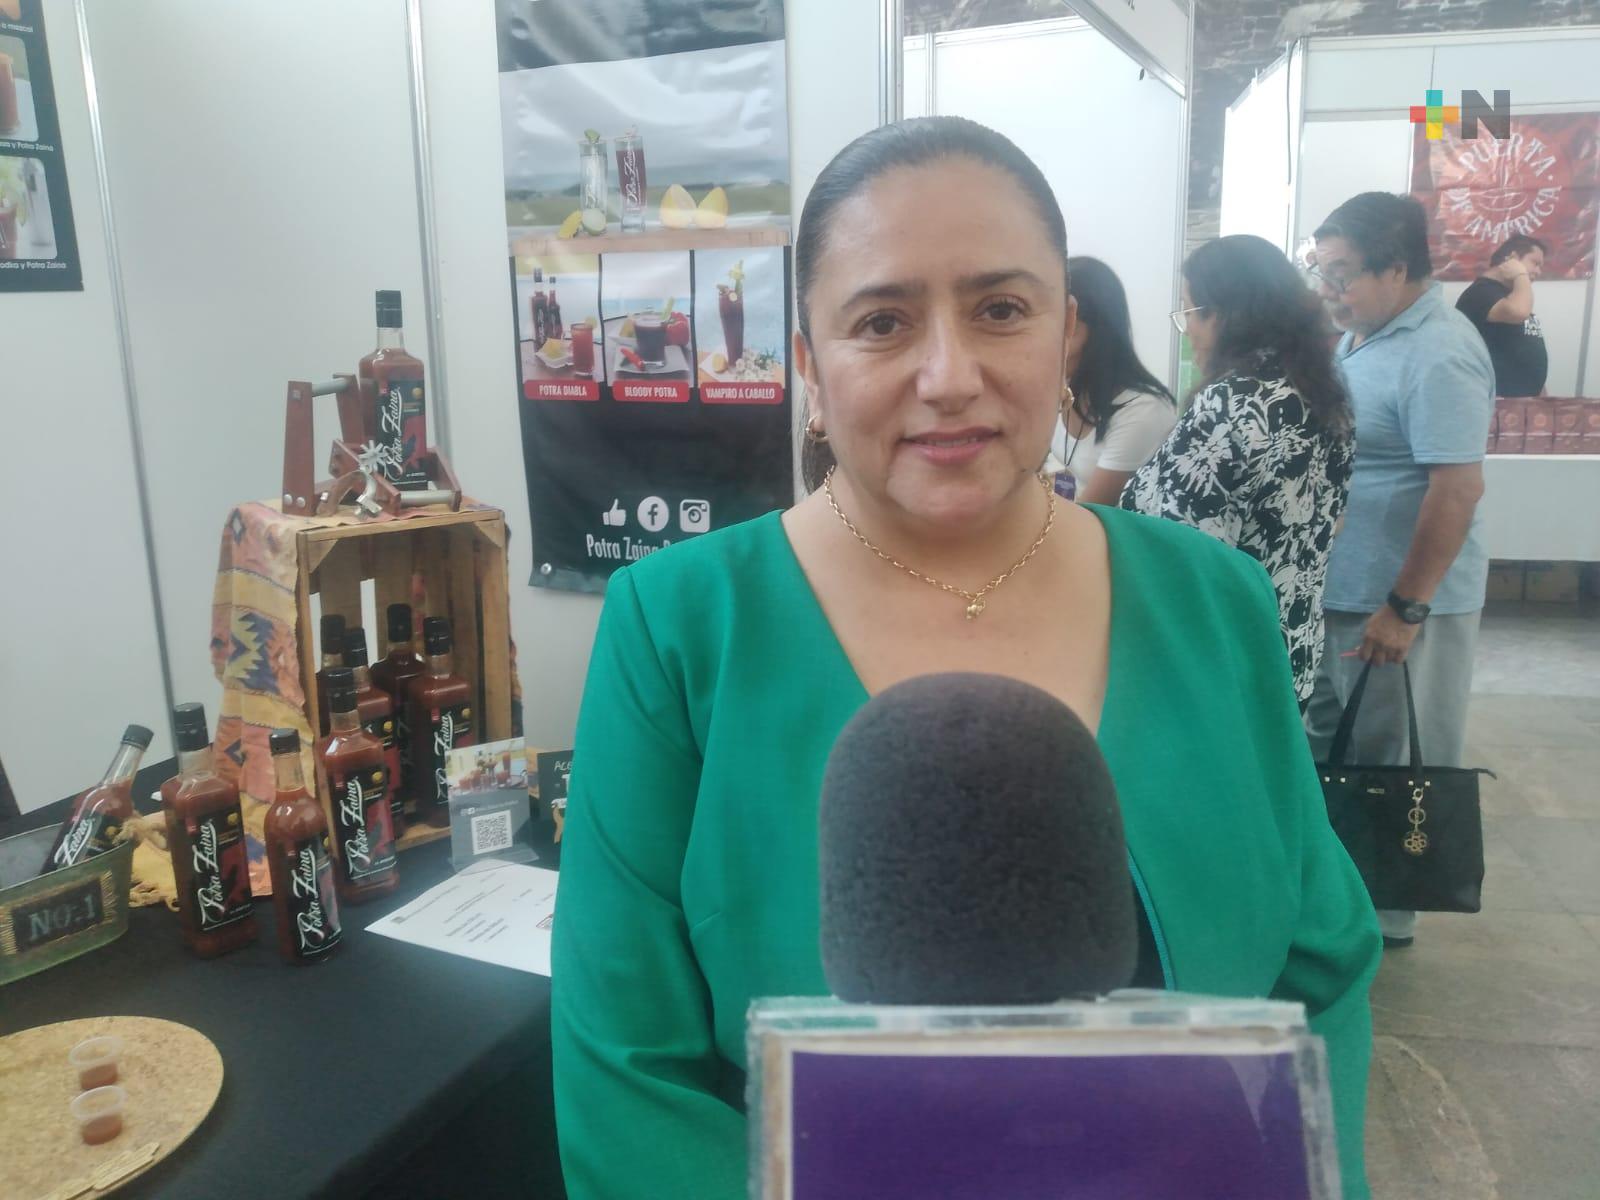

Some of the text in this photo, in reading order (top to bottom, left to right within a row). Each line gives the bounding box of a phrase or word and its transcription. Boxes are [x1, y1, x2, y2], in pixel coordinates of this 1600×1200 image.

[26, 261, 46, 269] Potra
[46, 261, 67, 269] Zaina
[539, 385, 588, 396] POTRA DIABLA
[625, 386, 678, 397] BLOODY POTRA
[705, 387, 775, 399] VAMPIRO A CABALLO
[586, 533, 621, 559] Potra
